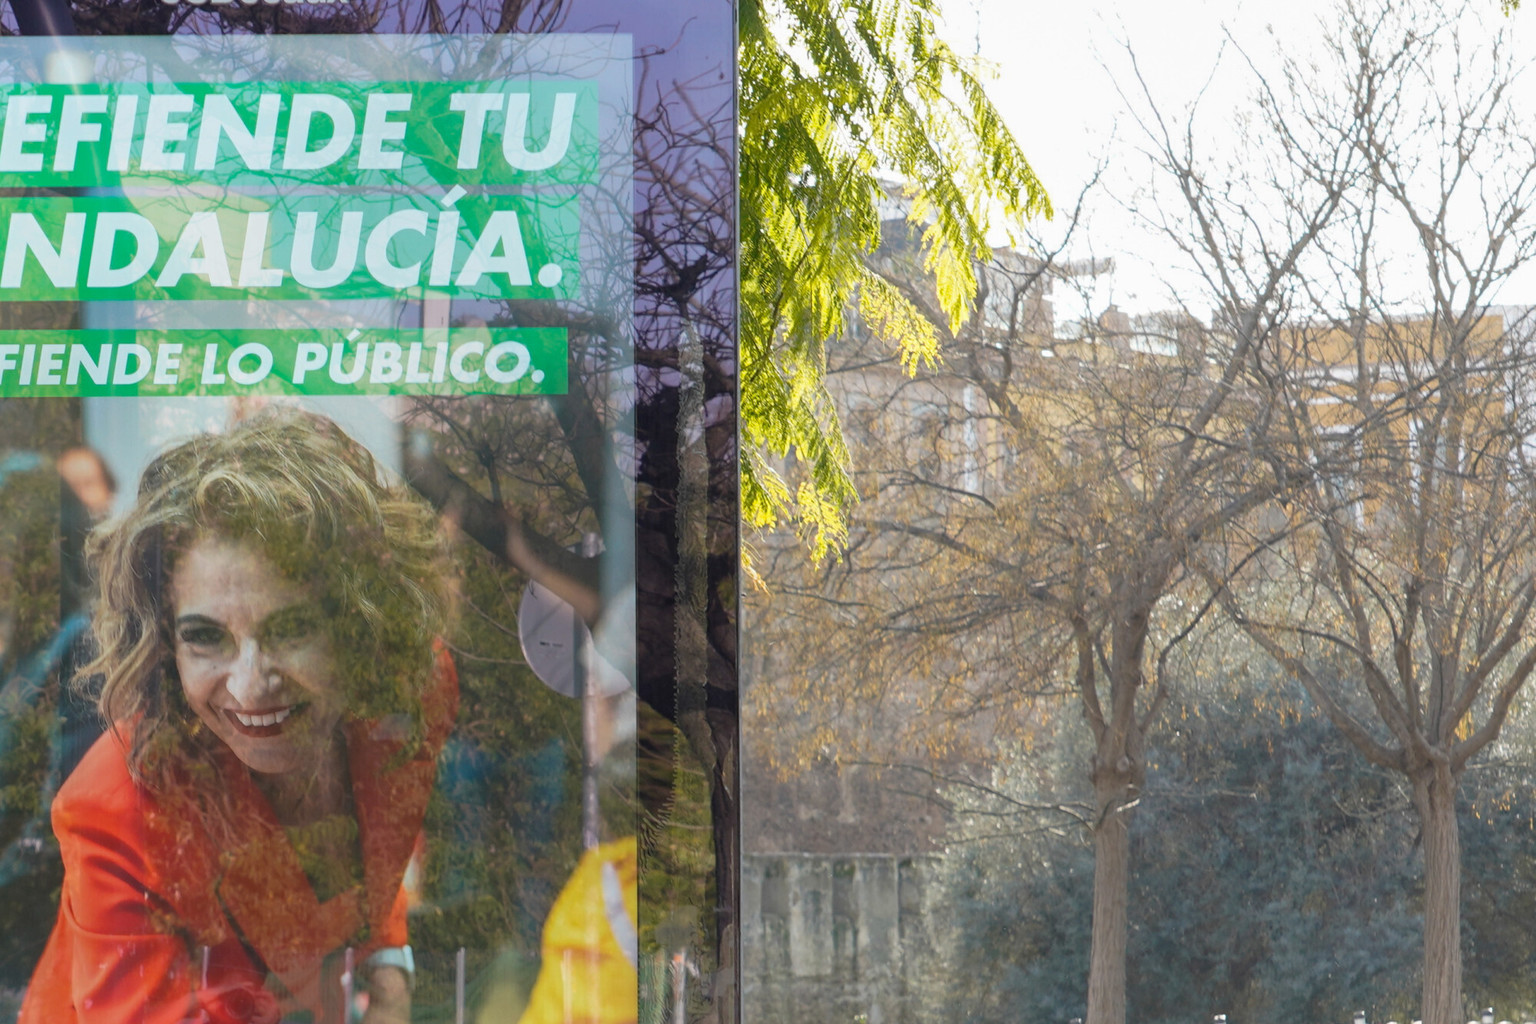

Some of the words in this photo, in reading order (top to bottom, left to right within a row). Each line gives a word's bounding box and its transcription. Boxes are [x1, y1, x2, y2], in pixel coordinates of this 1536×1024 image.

[450, 93, 577, 172] TU
[200, 342, 274, 385] LO
[292, 329, 546, 384] PÚBLICO.
